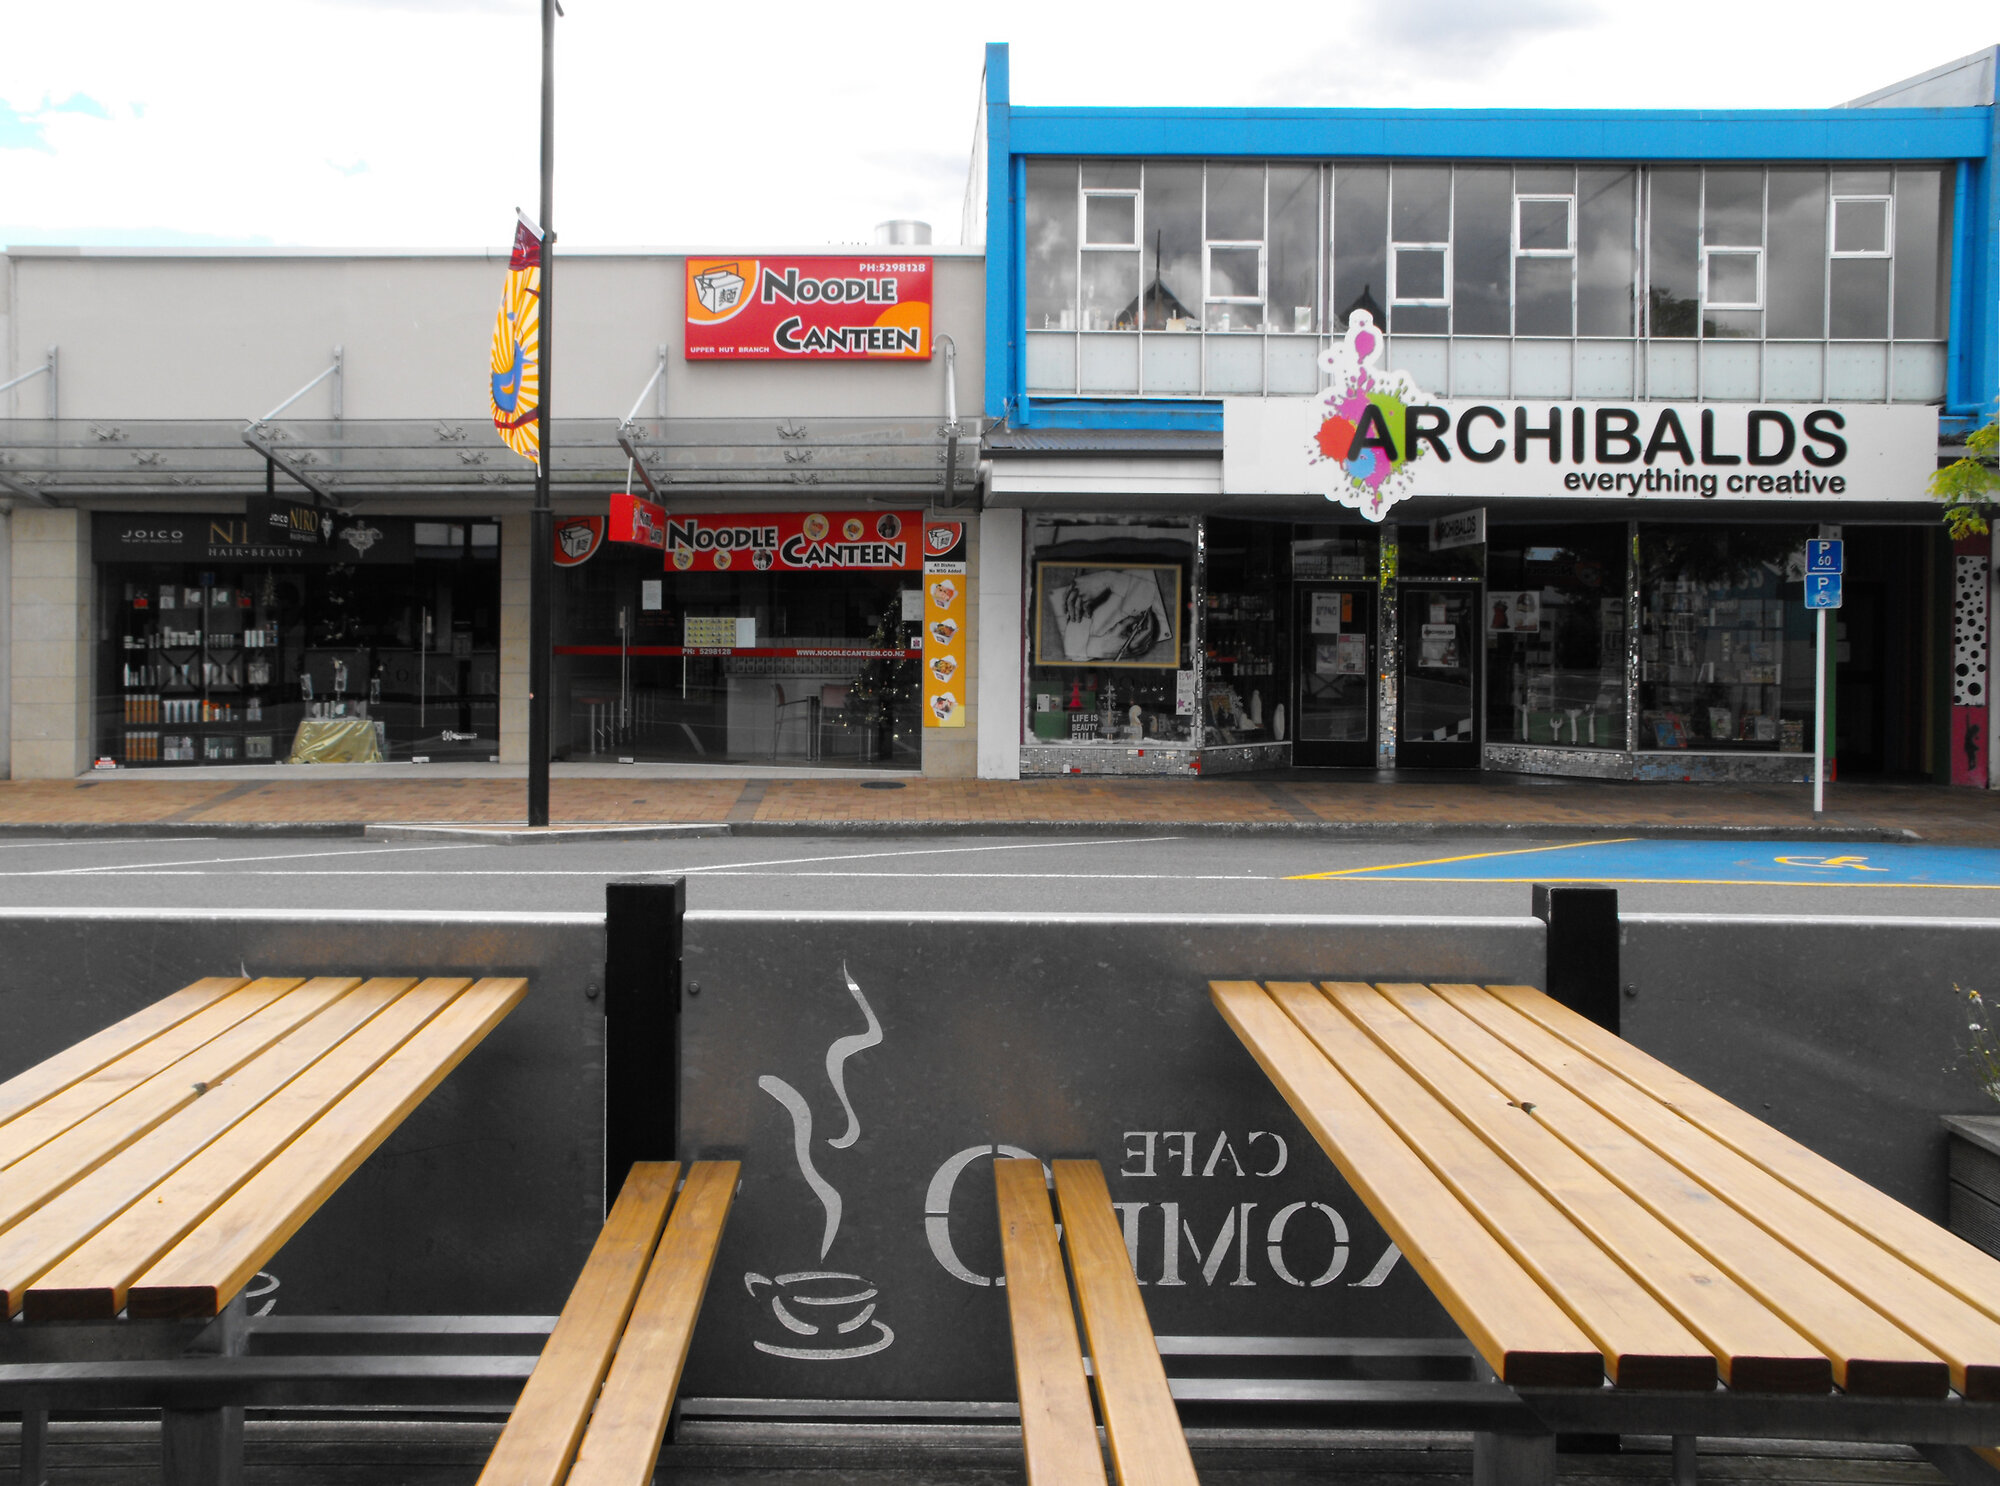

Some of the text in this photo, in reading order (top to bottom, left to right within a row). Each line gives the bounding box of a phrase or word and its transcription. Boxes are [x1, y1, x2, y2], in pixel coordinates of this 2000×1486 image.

[860, 263, 926, 272] PH:5298128
[761, 267, 898, 304] NOODLE
[774, 315, 920, 353] CANTEEN
[1346, 404, 1848, 466] ARCHIBALDS
[1563, 469, 1846, 498] everything creative
[289, 507, 319, 532] NIRO
[121, 530, 183, 539] JOICO
[667, 519, 778, 552] NOODLE
[780, 533, 906, 568] CANTEEN
[1818, 541, 1831, 554] P
[1818, 555, 1831, 566] 60
[1818, 577, 1829, 590] P
[796, 649, 905, 657] WWW.NOODLECANTEEN.CO.NZ
[1072, 714, 1099, 722] LIFE IS
[1072, 723, 1098, 731] BEAUTY
